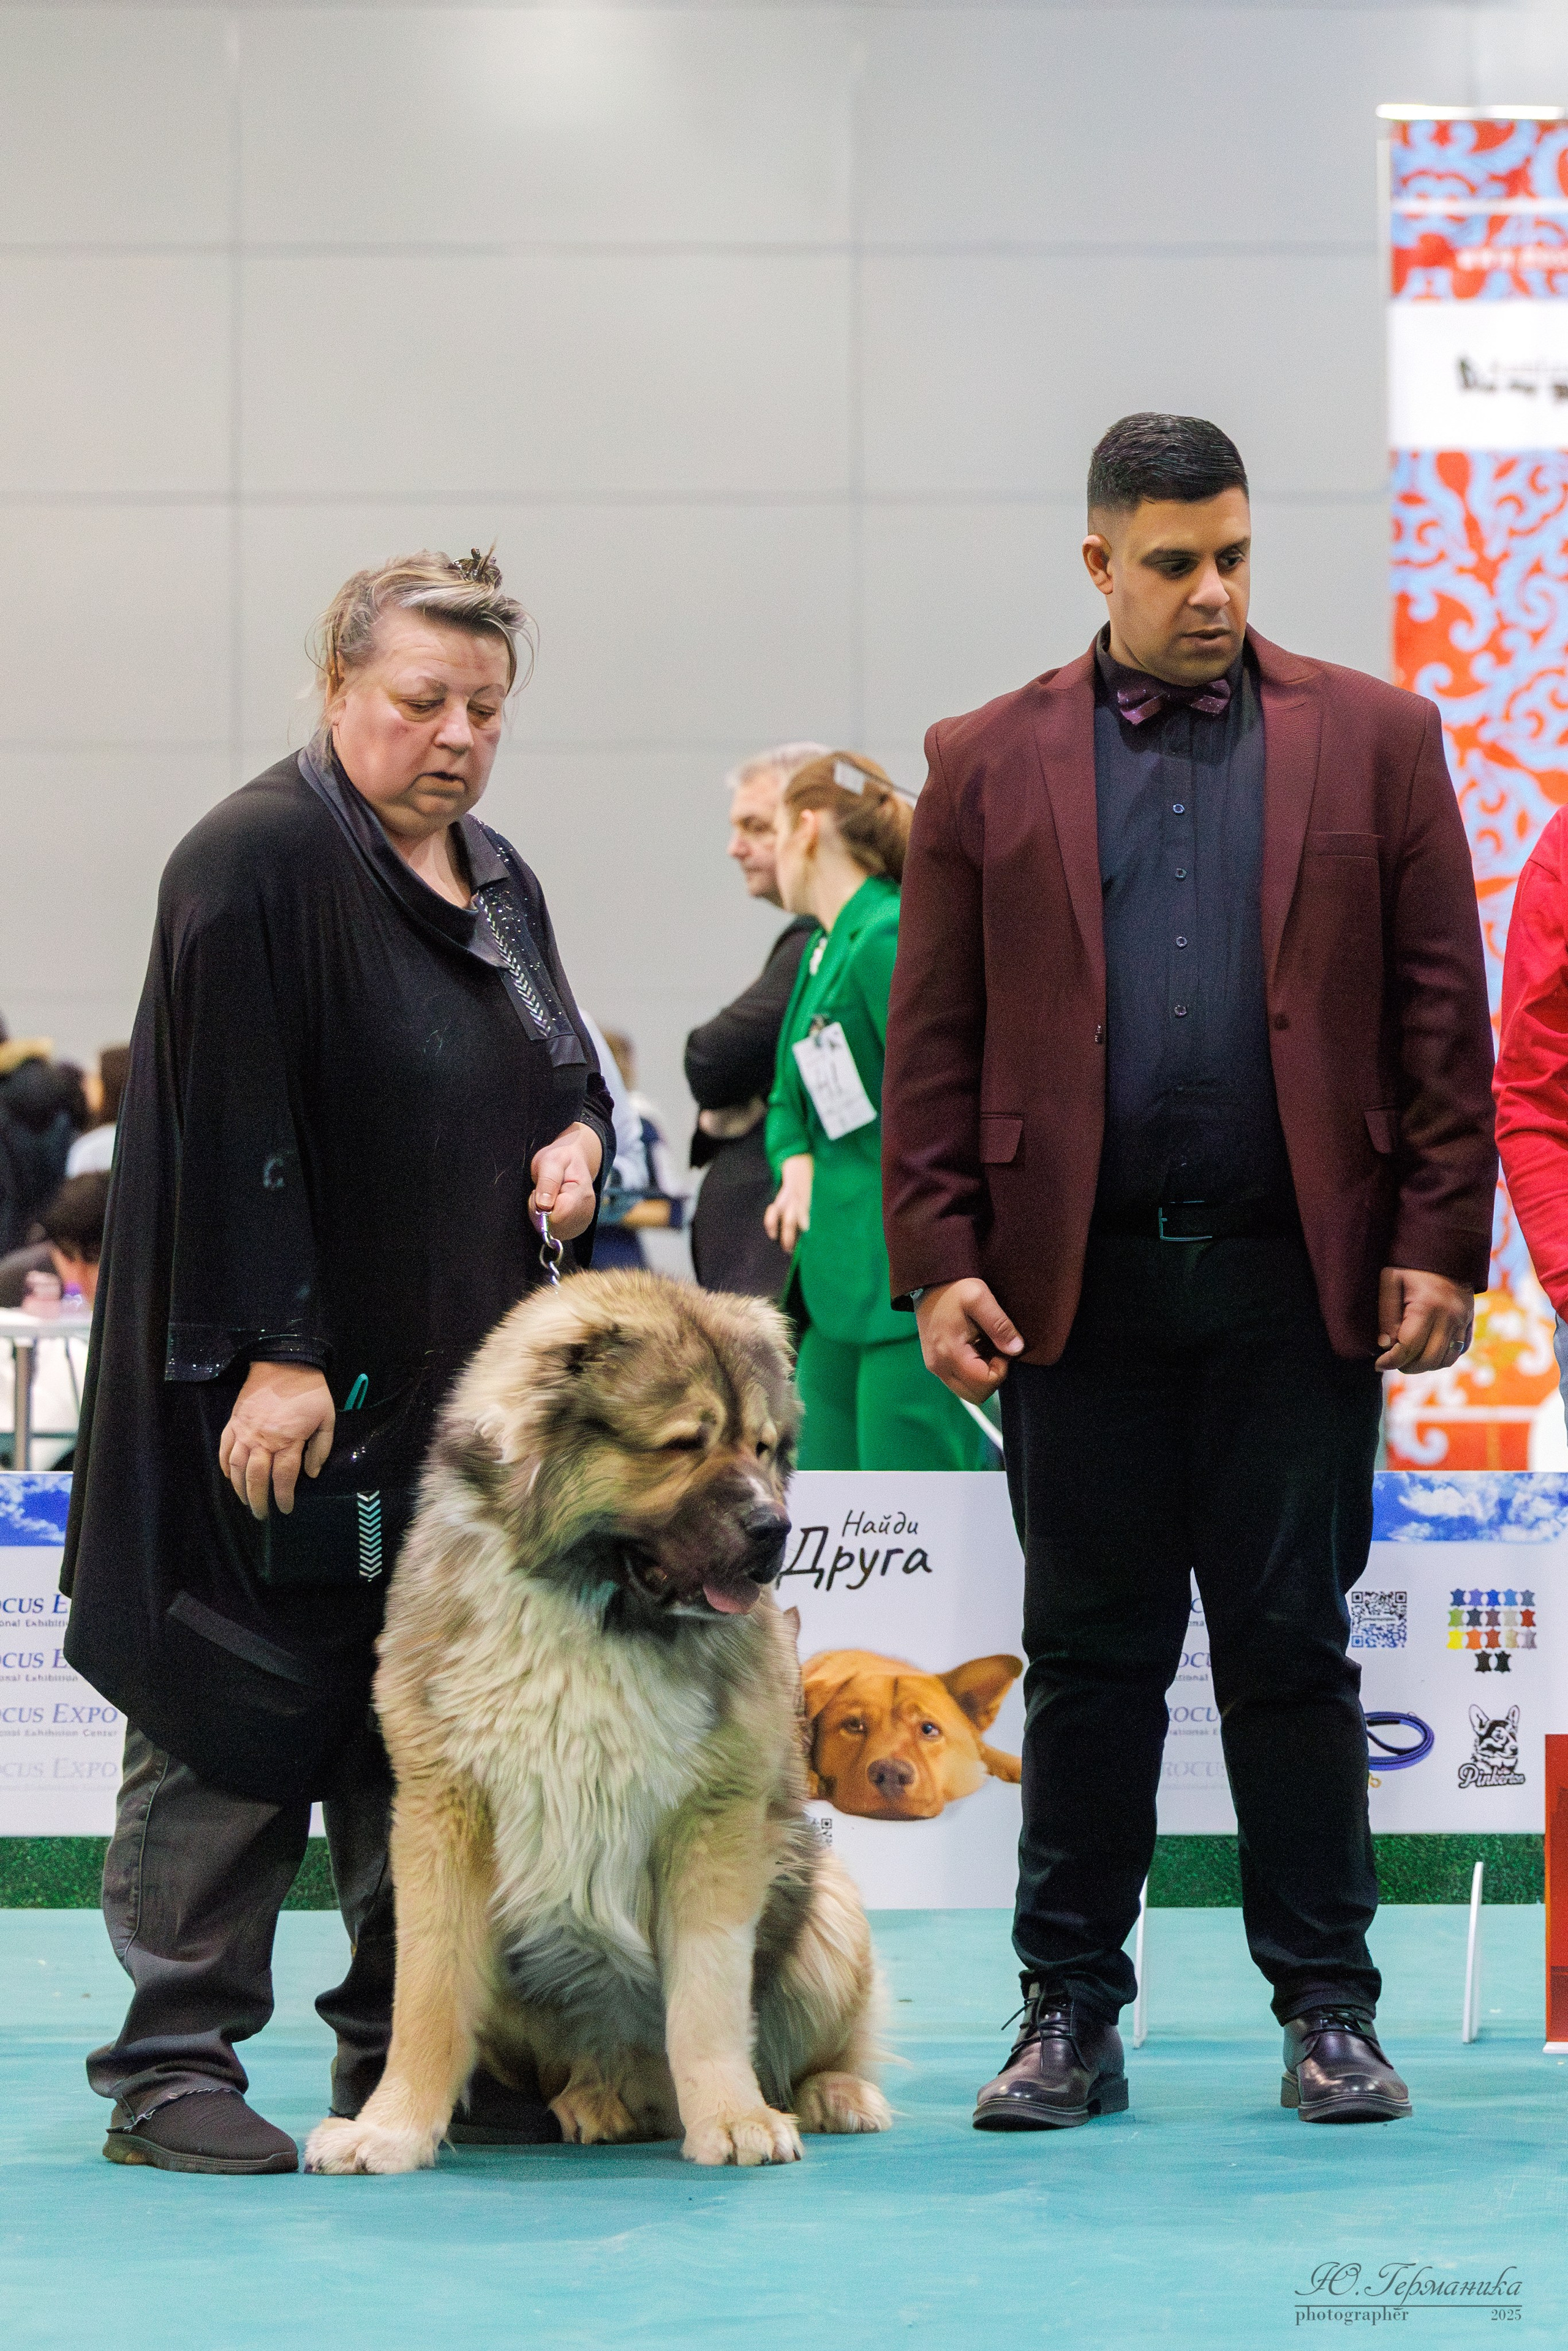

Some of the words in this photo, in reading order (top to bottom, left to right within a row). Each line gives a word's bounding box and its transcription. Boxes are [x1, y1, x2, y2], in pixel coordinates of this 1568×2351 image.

[842, 1509, 919, 1538] Найди
[776, 1525, 932, 1592] Друга
[0, 1598, 45, 1613] CUS
[0, 1652, 45, 1669] CUS
[0, 1707, 44, 1723] CUS
[53, 1703, 118, 1724] EXPO
[0, 1762, 44, 1778] CUS
